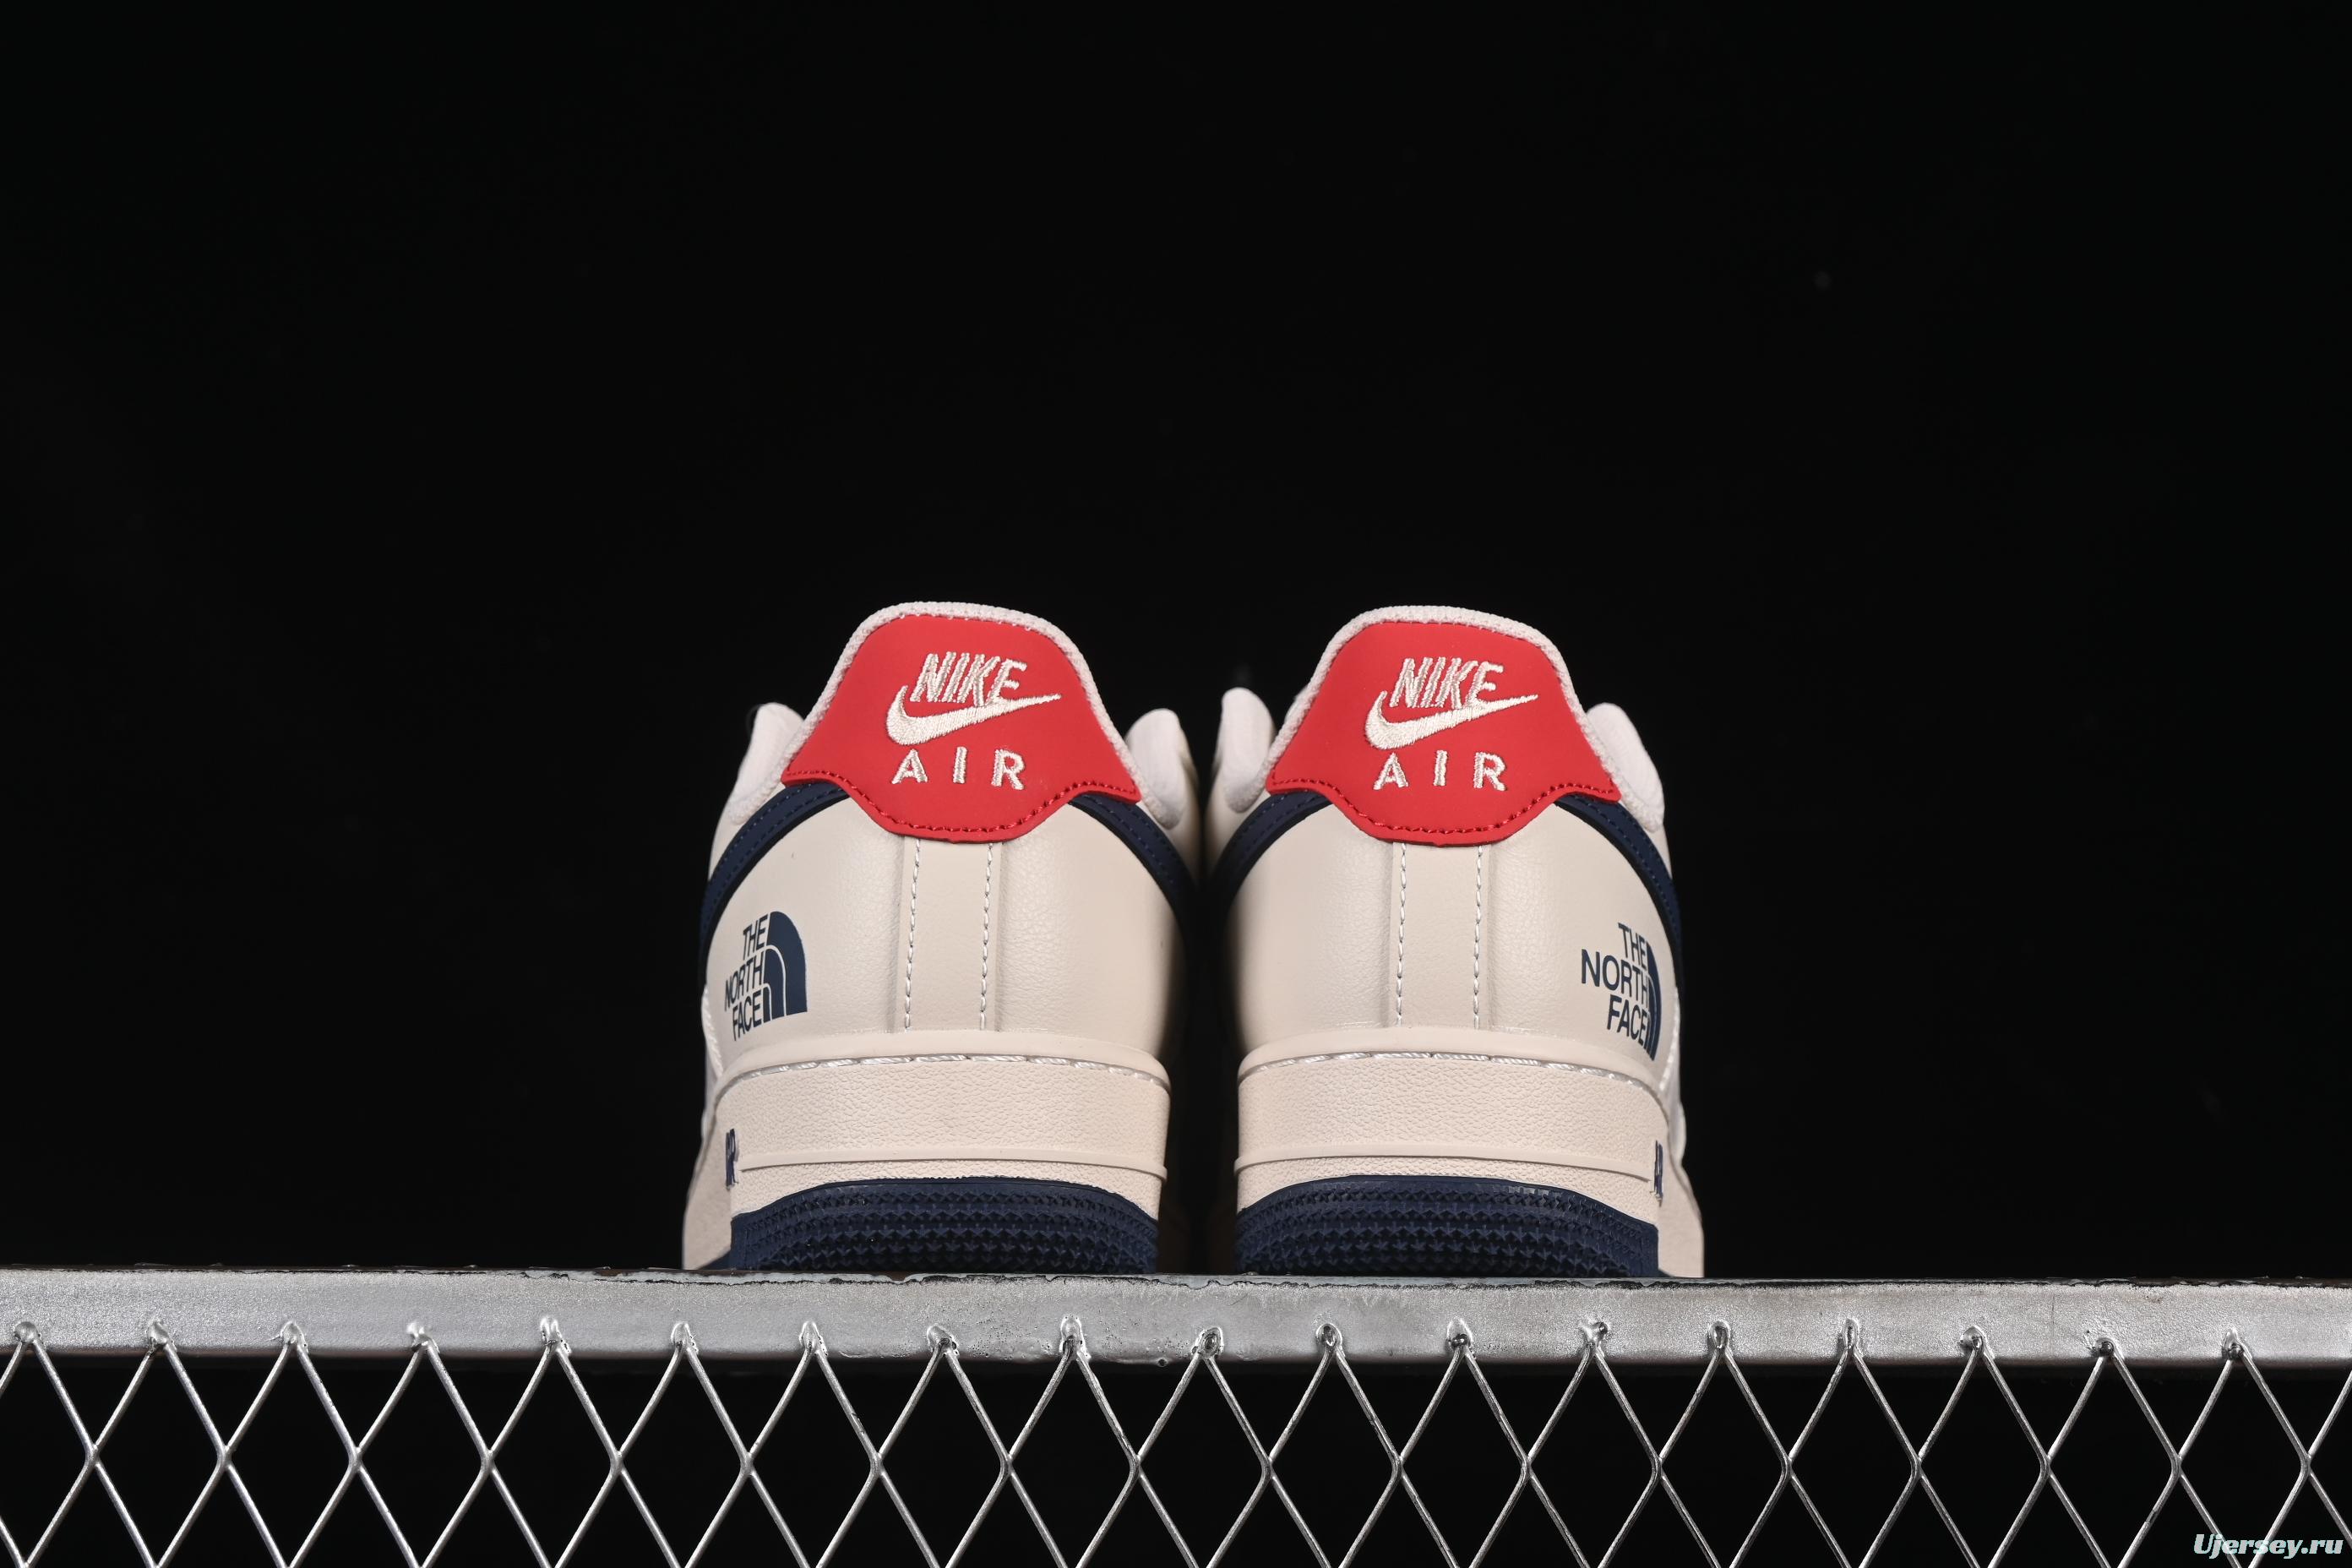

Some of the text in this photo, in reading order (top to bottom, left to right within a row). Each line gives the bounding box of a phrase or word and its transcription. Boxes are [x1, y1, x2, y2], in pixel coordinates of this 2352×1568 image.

[910, 651, 1028, 707] NIKE
[1389, 656, 1505, 710] NIKE
[891, 746, 1026, 791] AIR
[1373, 749, 1507, 792] AIR
[743, 913, 769, 961] THE
[1618, 922, 1647, 972] THE
[724, 950, 765, 1012] NORTH
[1581, 948, 1650, 1009] NORTH
[732, 989, 763, 1042] FACE
[1606, 994, 1649, 1047] FACE
